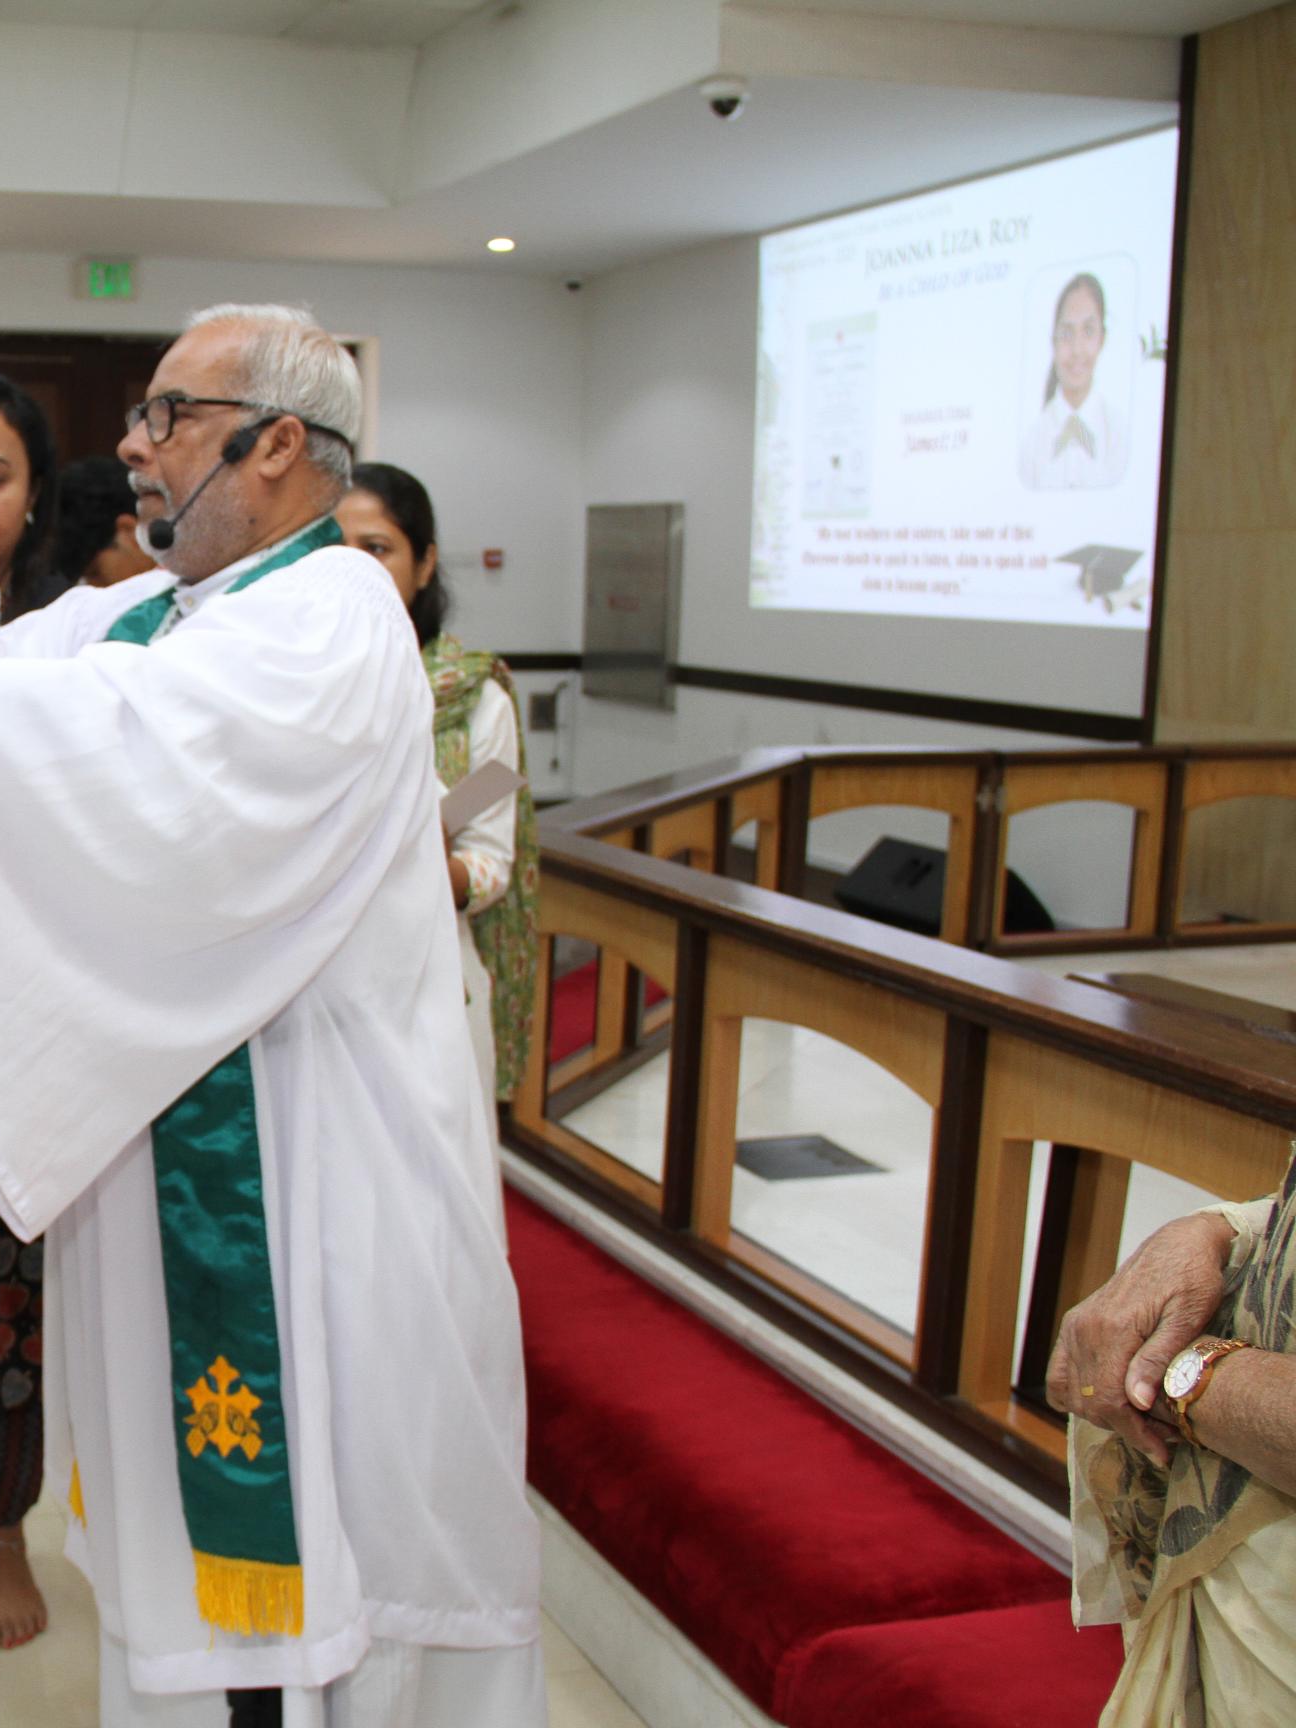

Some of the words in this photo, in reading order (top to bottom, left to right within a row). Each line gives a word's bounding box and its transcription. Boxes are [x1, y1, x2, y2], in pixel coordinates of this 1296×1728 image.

[865, 236, 933, 279] JOANNA
[941, 227, 981, 257] LIZA
[989, 214, 1032, 247] ROY
